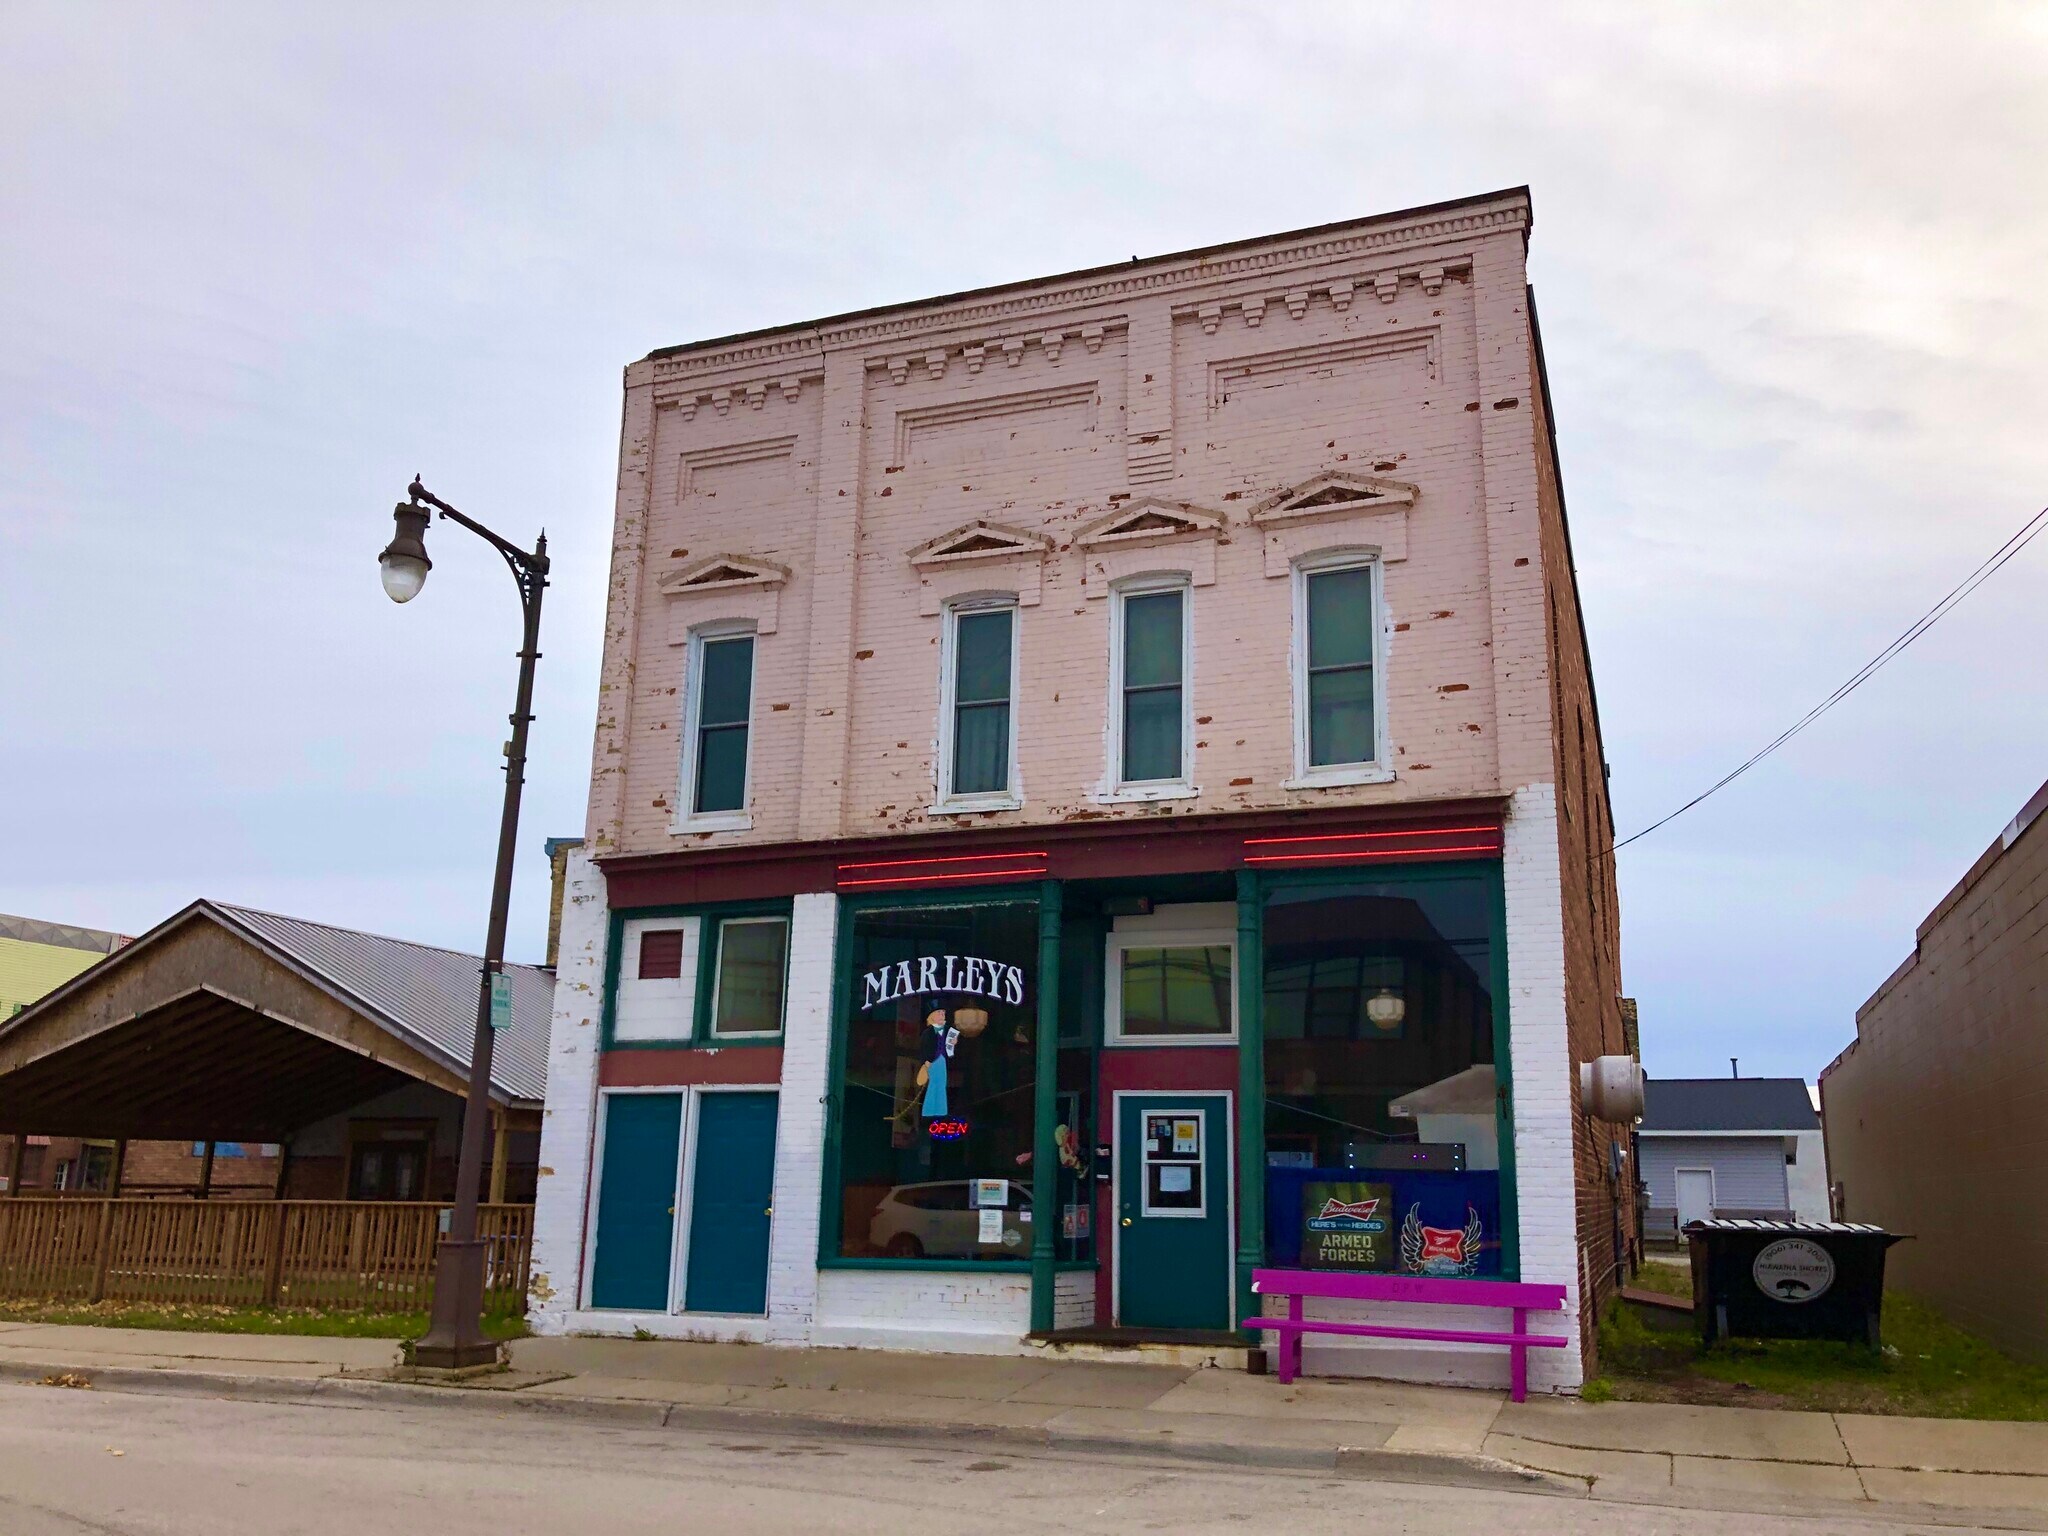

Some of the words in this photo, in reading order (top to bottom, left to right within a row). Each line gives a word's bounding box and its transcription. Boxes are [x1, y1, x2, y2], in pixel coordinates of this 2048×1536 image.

[861, 955, 1023, 1010] MARLEYS
[928, 1122, 968, 1134] OPEN
[1319, 1203, 1377, 1214] Budweiser
[1322, 1234, 1372, 1248] ARMED
[1320, 1248, 1376, 1262] FORCES
[1760, 1263, 1797, 1271] HIAWATHA
